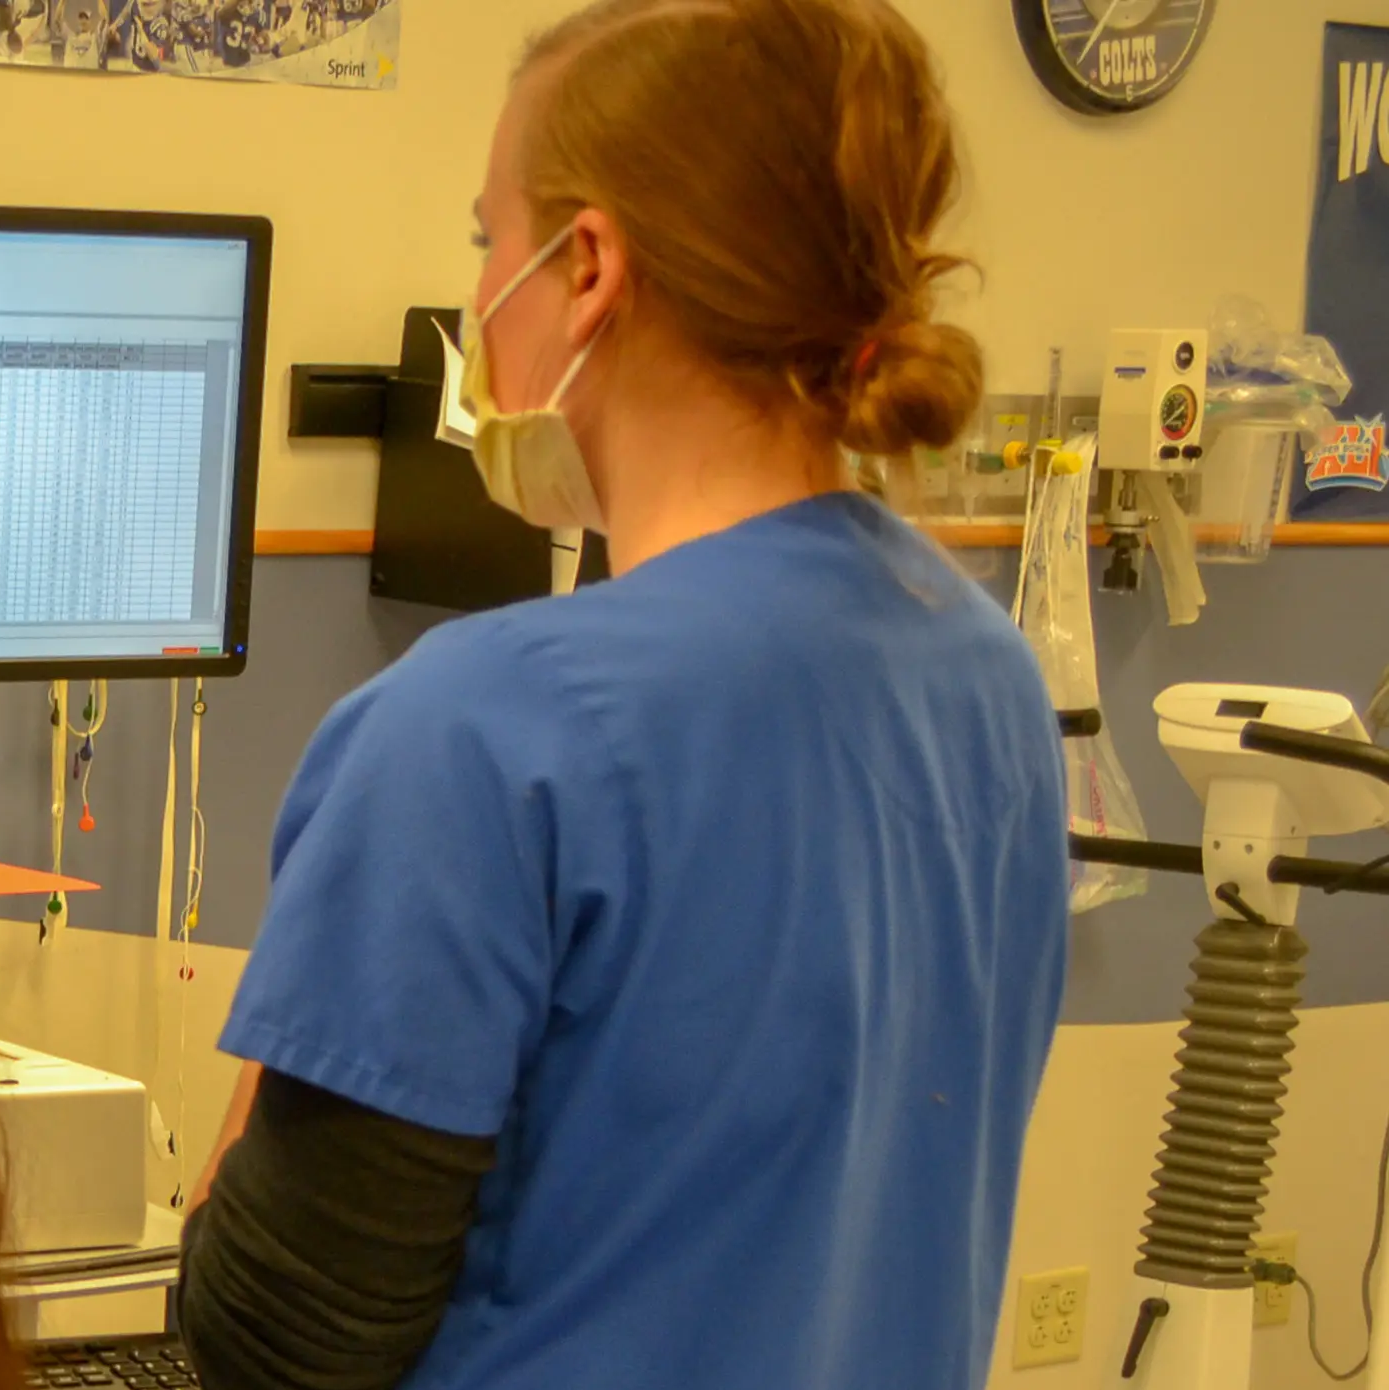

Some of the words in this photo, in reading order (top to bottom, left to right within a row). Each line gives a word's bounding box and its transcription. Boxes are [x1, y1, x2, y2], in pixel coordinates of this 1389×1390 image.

[328, 59, 365, 78] Sprint
[1099, 35, 1156, 86] COLTS
[1338, 62, 1388, 182] W
